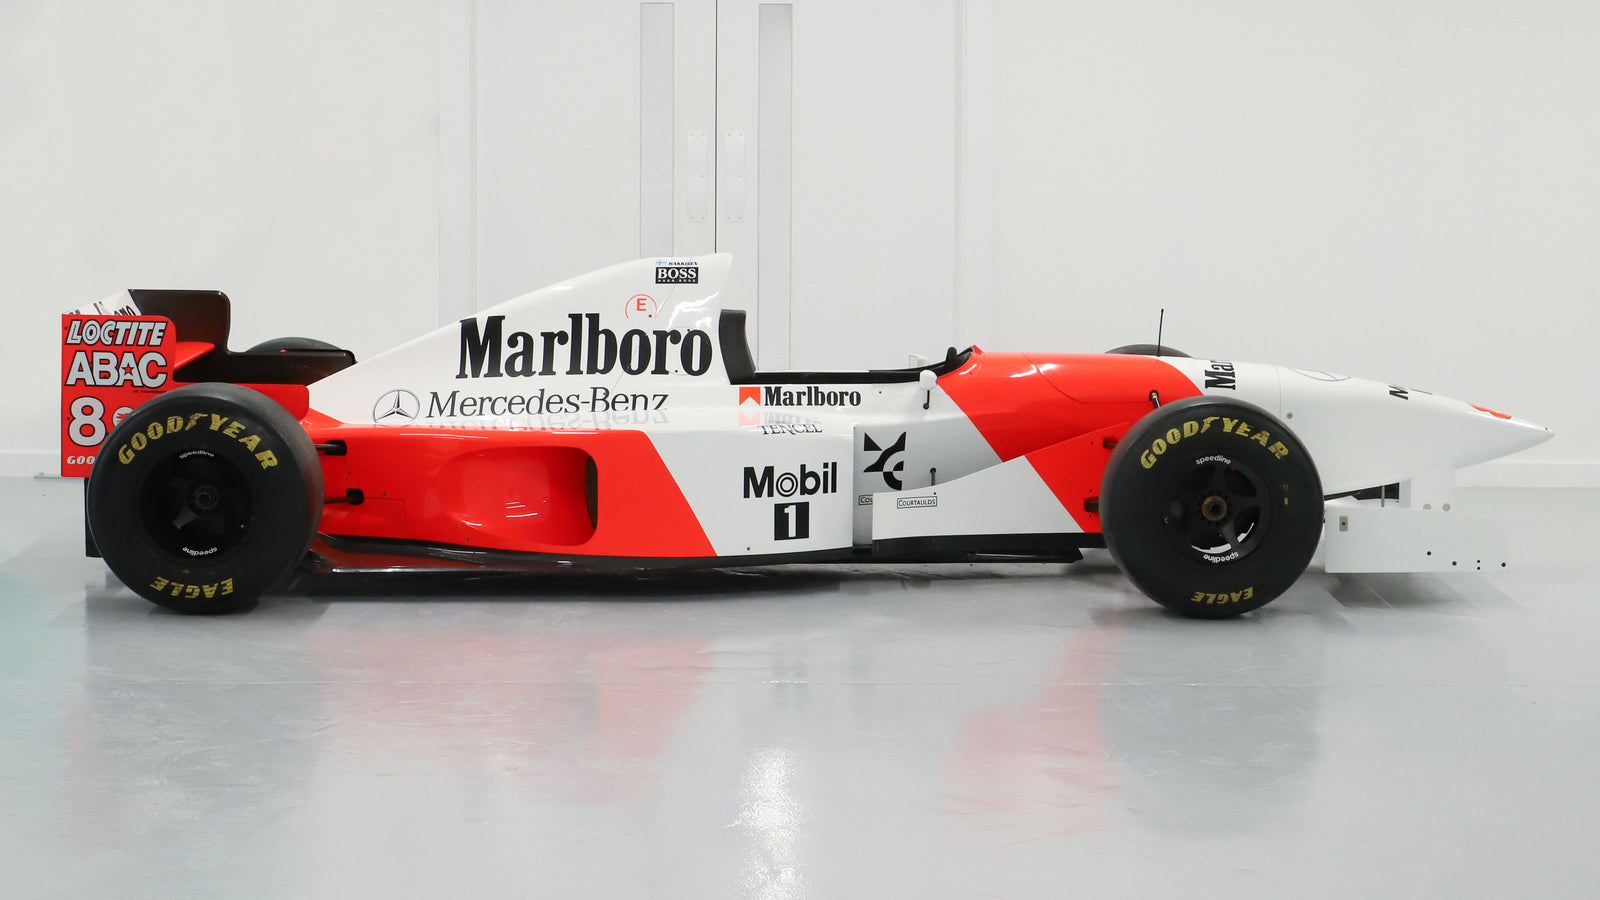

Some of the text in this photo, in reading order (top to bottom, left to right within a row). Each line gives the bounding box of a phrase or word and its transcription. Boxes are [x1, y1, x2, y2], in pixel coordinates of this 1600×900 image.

[657, 268, 697, 279] BOSS
[636, 298, 647, 312] E
[65, 319, 168, 346] LOCTITE
[455, 312, 713, 379] Marlboro
[65, 350, 168, 388] ABAC
[425, 386, 669, 418] Mercedes-Benz
[764, 386, 861, 406] Marlboro
[68, 396, 107, 447] 8
[757, 423, 823, 435] TENCEL
[118, 412, 278, 470] GOODYEAR
[1140, 416, 1289, 469] GOODYEAR
[179, 449, 215, 459] speedline
[1195, 455, 1231, 465] speedline
[743, 462, 837, 499] Mobil
[898, 499, 936, 507] COURTAULDS
[784, 504, 796, 538] 1
[182, 546, 218, 556] speedline
[1203, 551, 1239, 563] speedline
[150, 576, 234, 599] EAGLE
[1191, 586, 1254, 604] EAGLE
